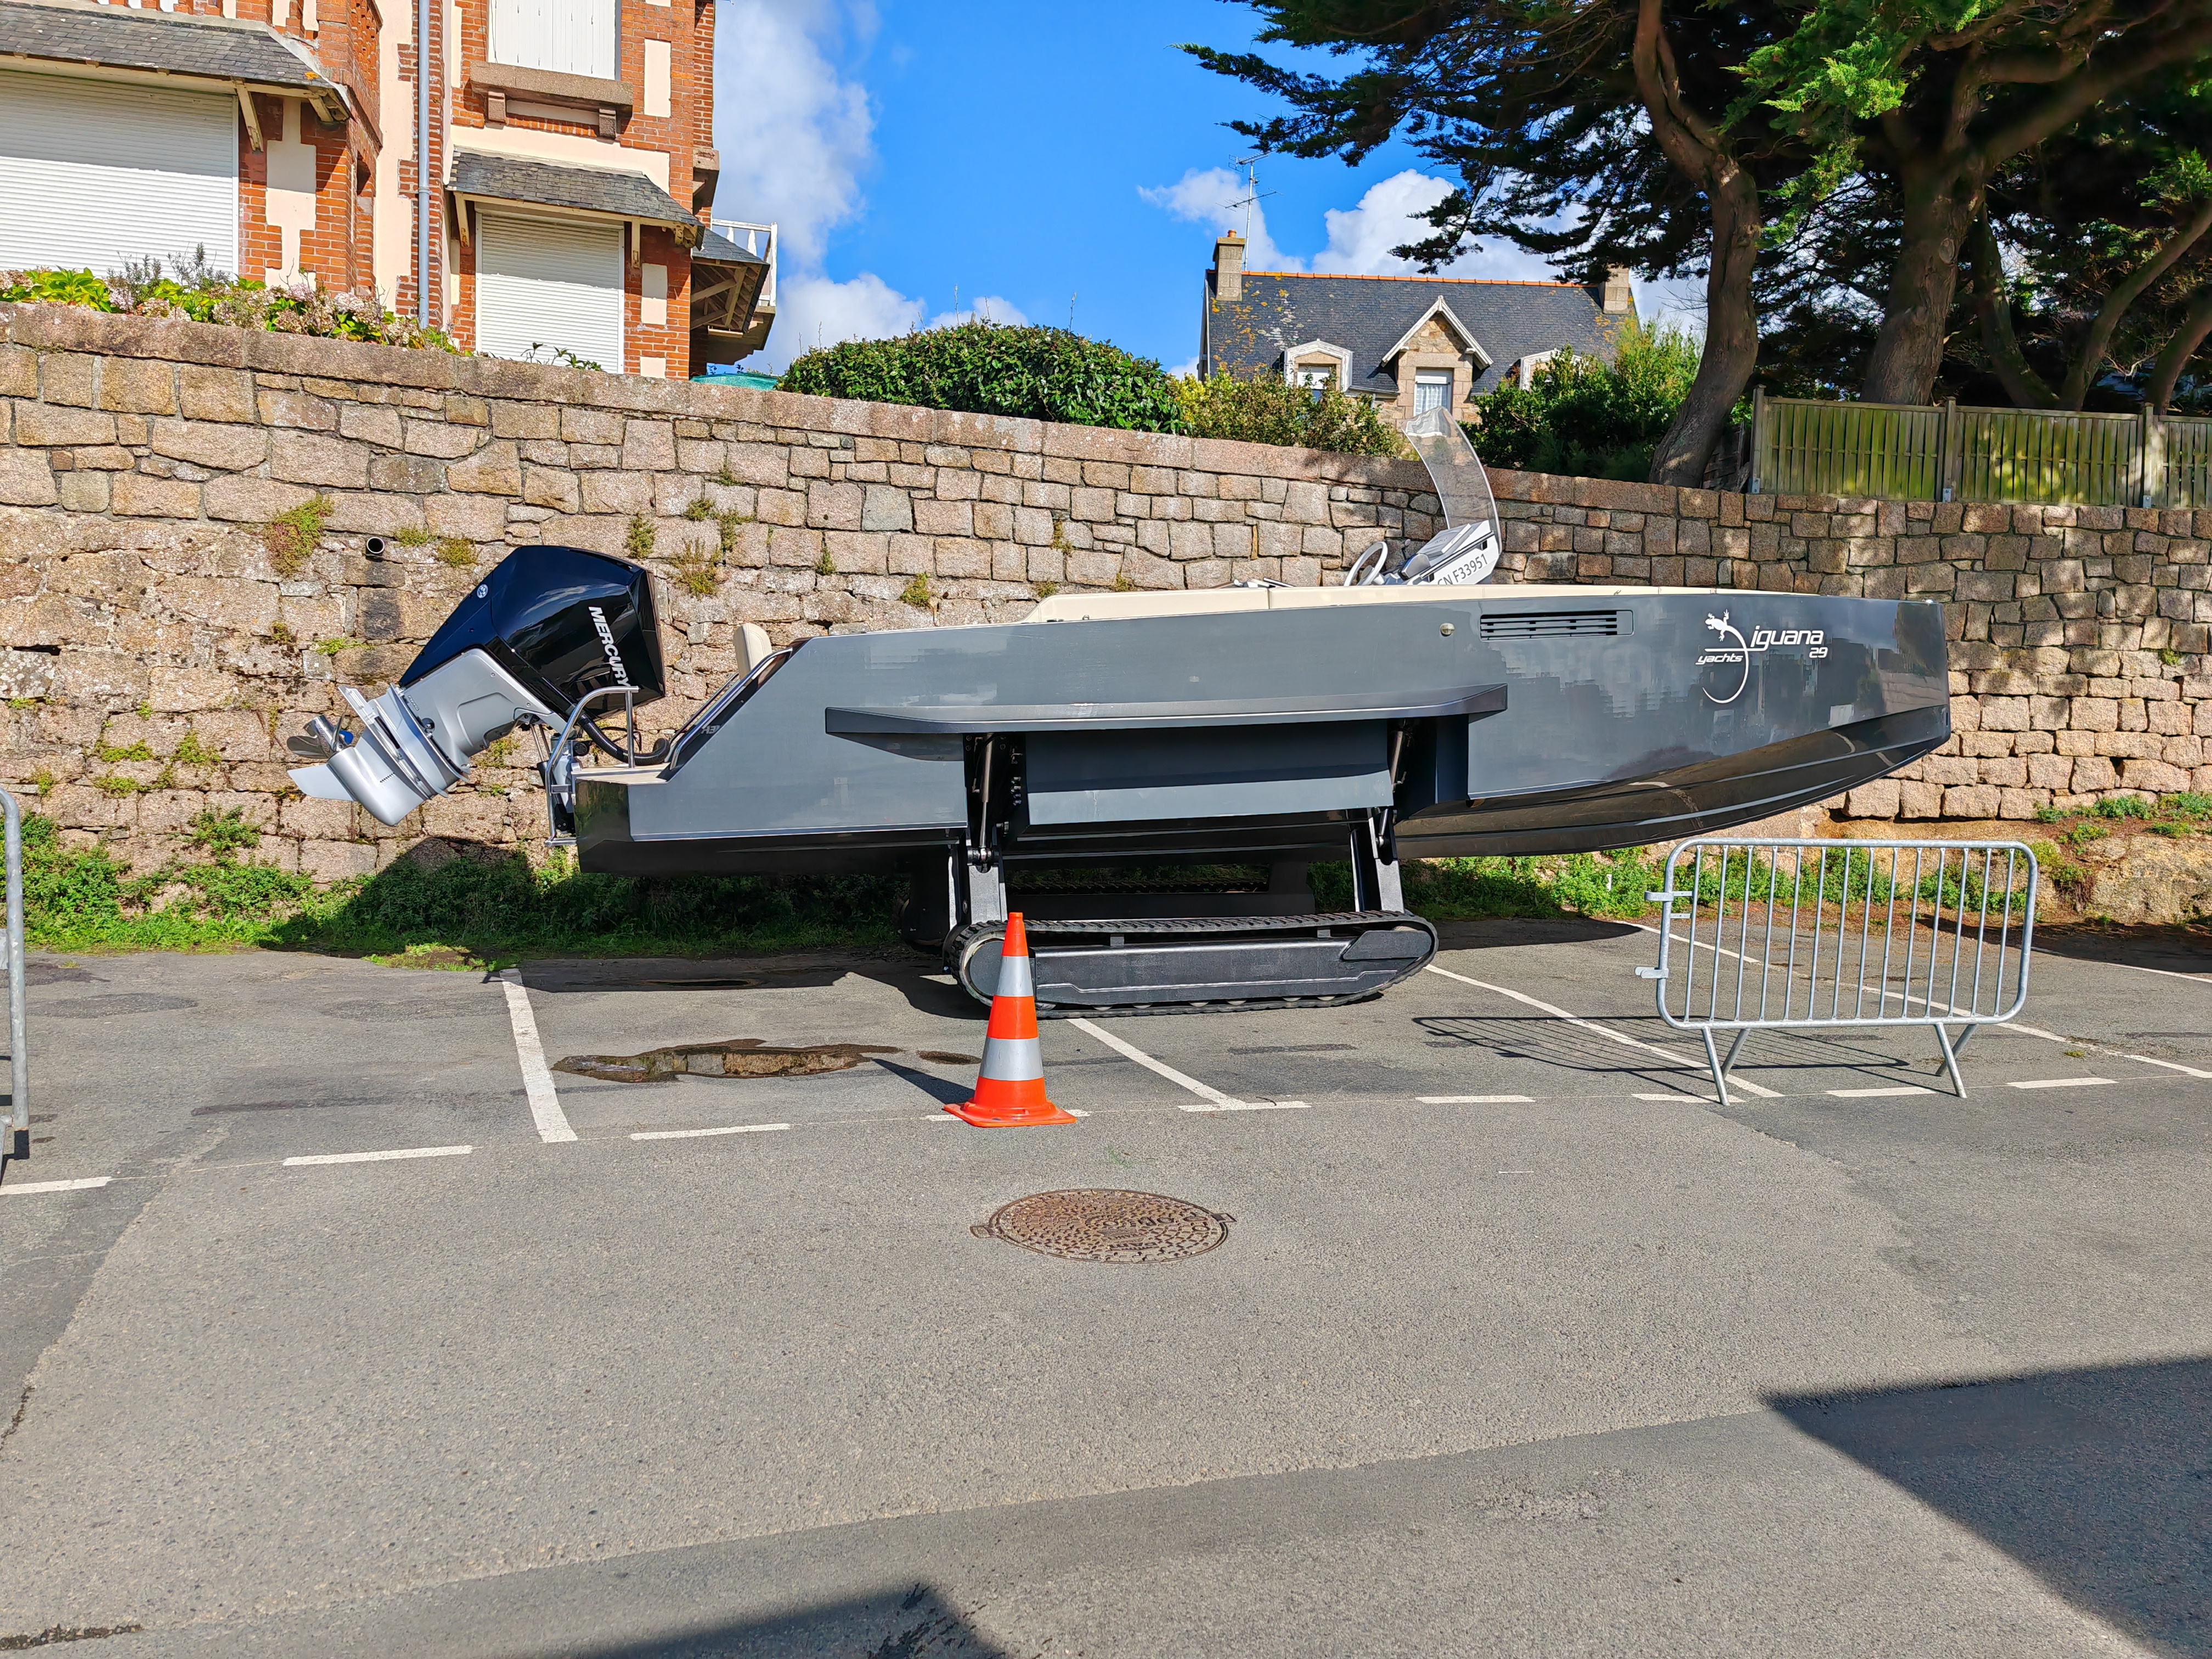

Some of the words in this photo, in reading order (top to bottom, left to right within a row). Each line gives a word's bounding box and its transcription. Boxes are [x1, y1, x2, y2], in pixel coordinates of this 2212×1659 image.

[1453, 554, 1488, 583] F33951
[589, 607, 630, 686] MERCURY
[1750, 625, 1824, 651] iguana
[1695, 653, 1743, 665] yachts
[1809, 647, 1828, 658] 29
